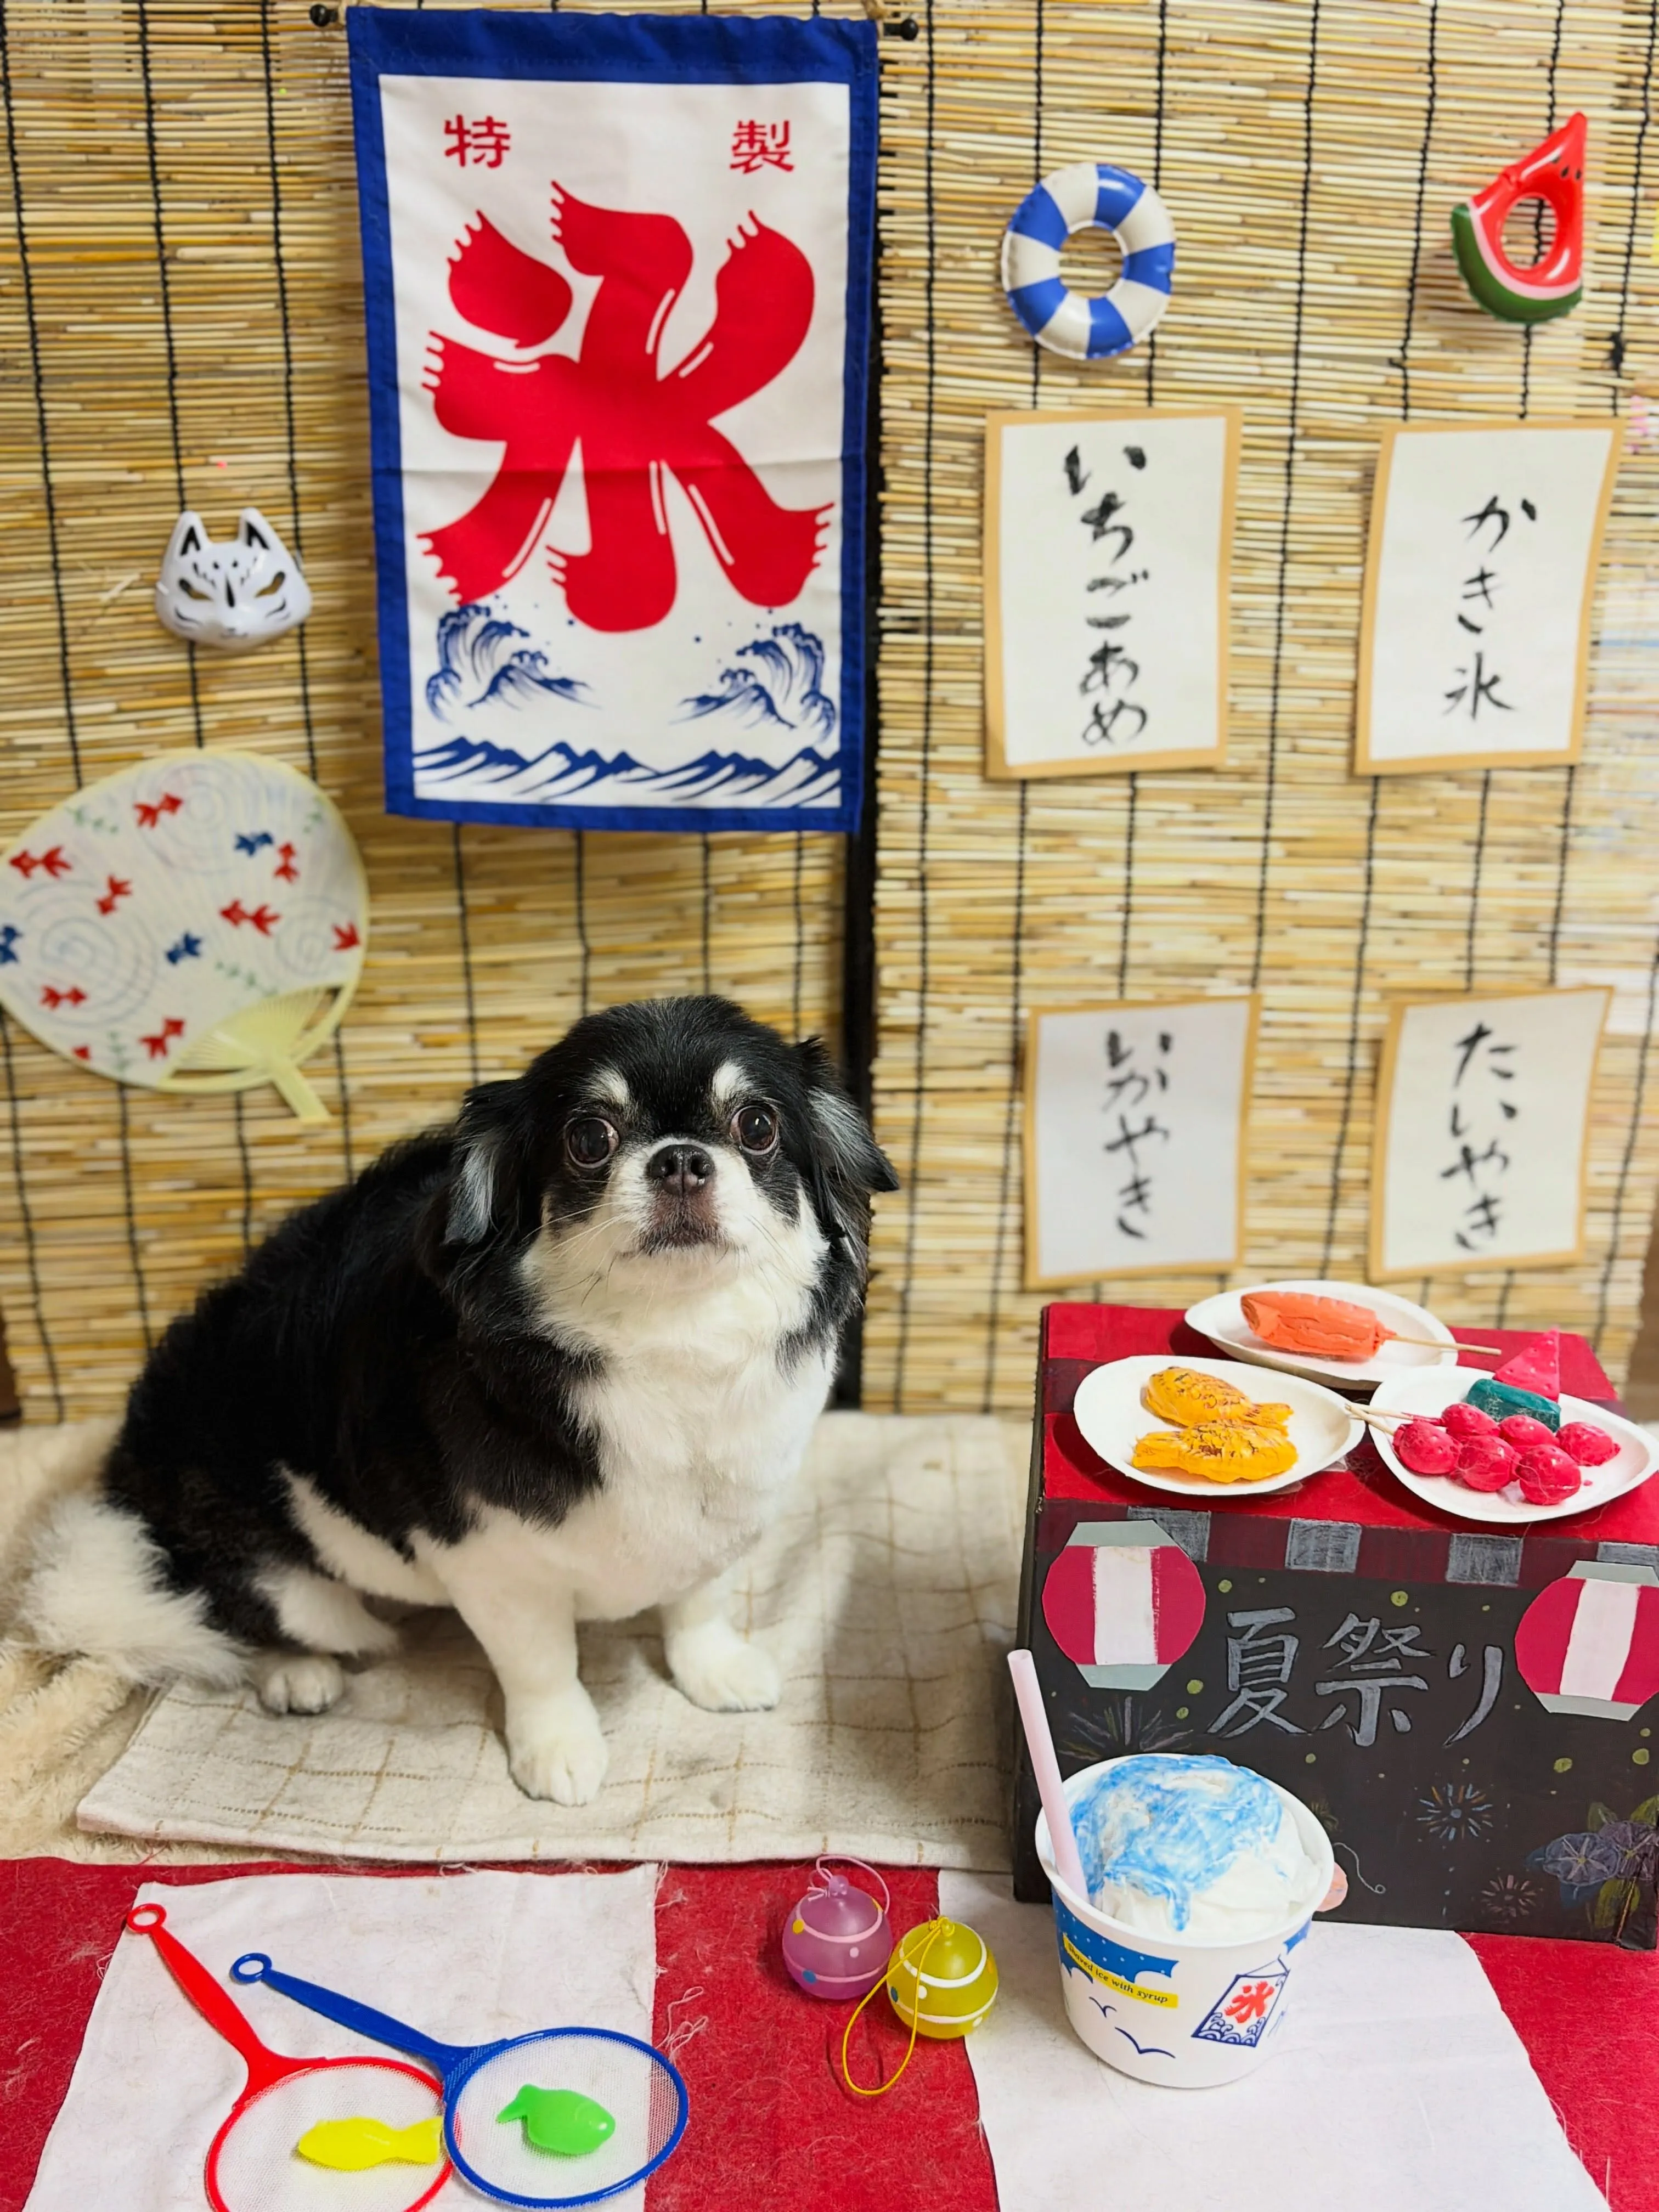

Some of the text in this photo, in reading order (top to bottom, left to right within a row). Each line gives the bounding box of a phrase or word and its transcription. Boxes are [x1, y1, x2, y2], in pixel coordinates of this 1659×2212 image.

[444, 114, 794, 174] 特 製
[416, 180, 834, 634] 氷
[1064, 444, 1148, 747] いちごあめ
[1443, 495, 1536, 721] かき氷
[1102, 1029, 1171, 1240] いかやき
[1441, 1021, 1520, 1251] たいやき
[1207, 1606, 1503, 1747] 夏祭り
[1111, 1978, 1133, 1994] with
[1137, 1989, 1168, 2004] syrup
[1224, 1980, 1275, 2024] 氷
